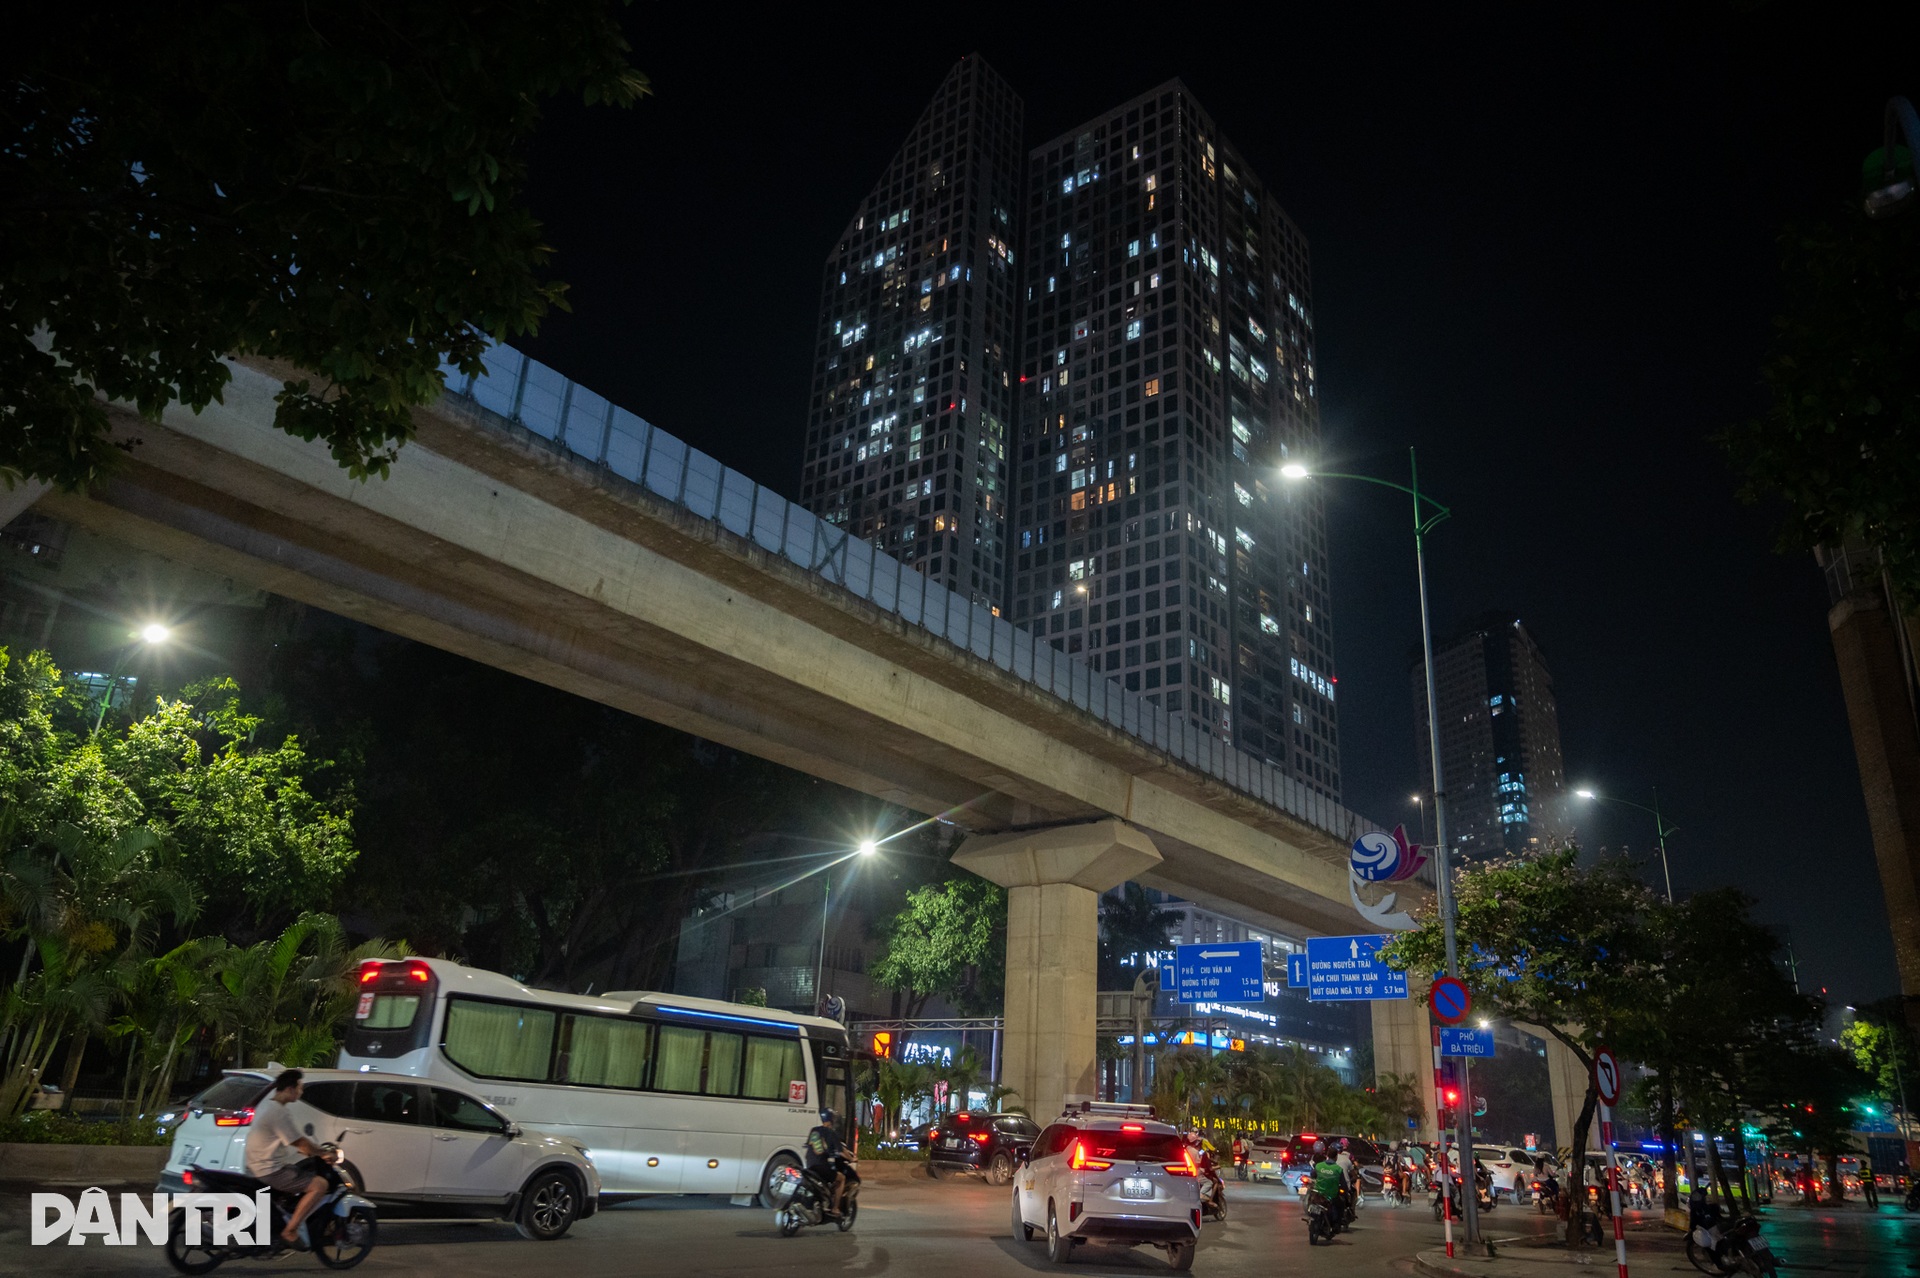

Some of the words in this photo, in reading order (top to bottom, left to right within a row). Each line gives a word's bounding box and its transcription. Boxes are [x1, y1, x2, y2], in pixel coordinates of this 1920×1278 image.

[1181, 964, 1195, 974] PHỐ
[1200, 966, 1211, 974] CHU
[1250, 977, 1259, 985] km
[1326, 974, 1339, 982] CHUI
[1341, 973, 1360, 982] THANH
[1362, 972, 1378, 981] XUÂN
[1394, 973, 1404, 981] km
[1243, 990, 1250, 998] 11
[1251, 990, 1260, 998] km
[1312, 985, 1324, 996] NÚT
[1325, 987, 1339, 996] GIAO
[1384, 986, 1393, 994] 5.7
[1394, 986, 1405, 994] km
[1459, 1029, 1475, 1041] PHỐ
[1450, 1042, 1462, 1053] BÀ
[1462, 1043, 1484, 1054] TRIỆU
[1320, 1167, 1334, 1175] Grab
